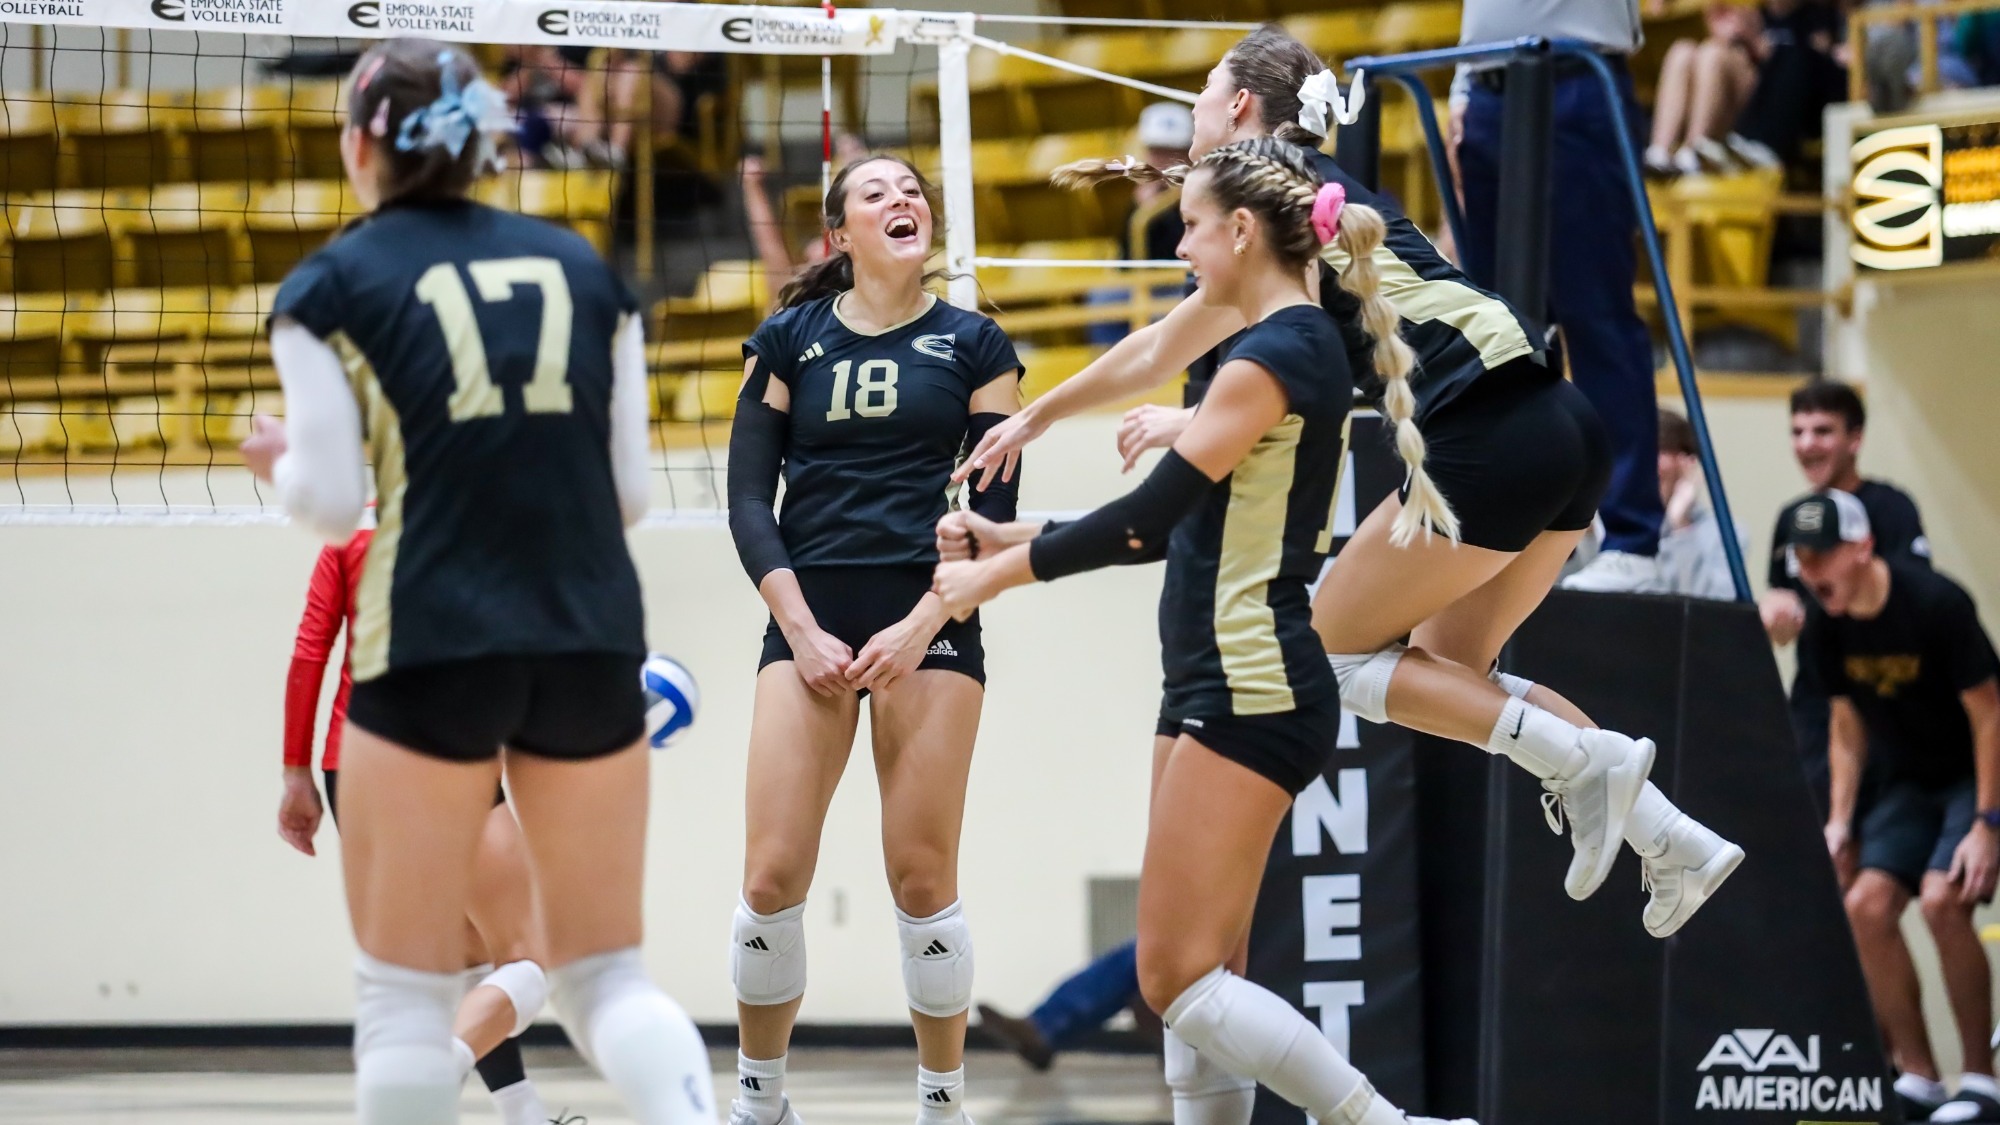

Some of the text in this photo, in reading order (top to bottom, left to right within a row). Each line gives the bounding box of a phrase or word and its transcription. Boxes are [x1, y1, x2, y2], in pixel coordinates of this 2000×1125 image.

[0, 2, 84, 16] OLLEYBALL
[191, 0, 282, 11] EMPORIA STATE
[386, 4, 474, 19] EMPORIA STATE
[192, 10, 282, 24] VOLLEYBALL
[388, 18, 474, 32] VOLLEYBALL
[575, 26, 660, 39] VOLLEYBALL
[415, 256, 573, 424] 17
[826, 359, 899, 422] 18
[926, 648, 958, 657] adidas
[1695, 1075, 1883, 1112] AMERICAN
